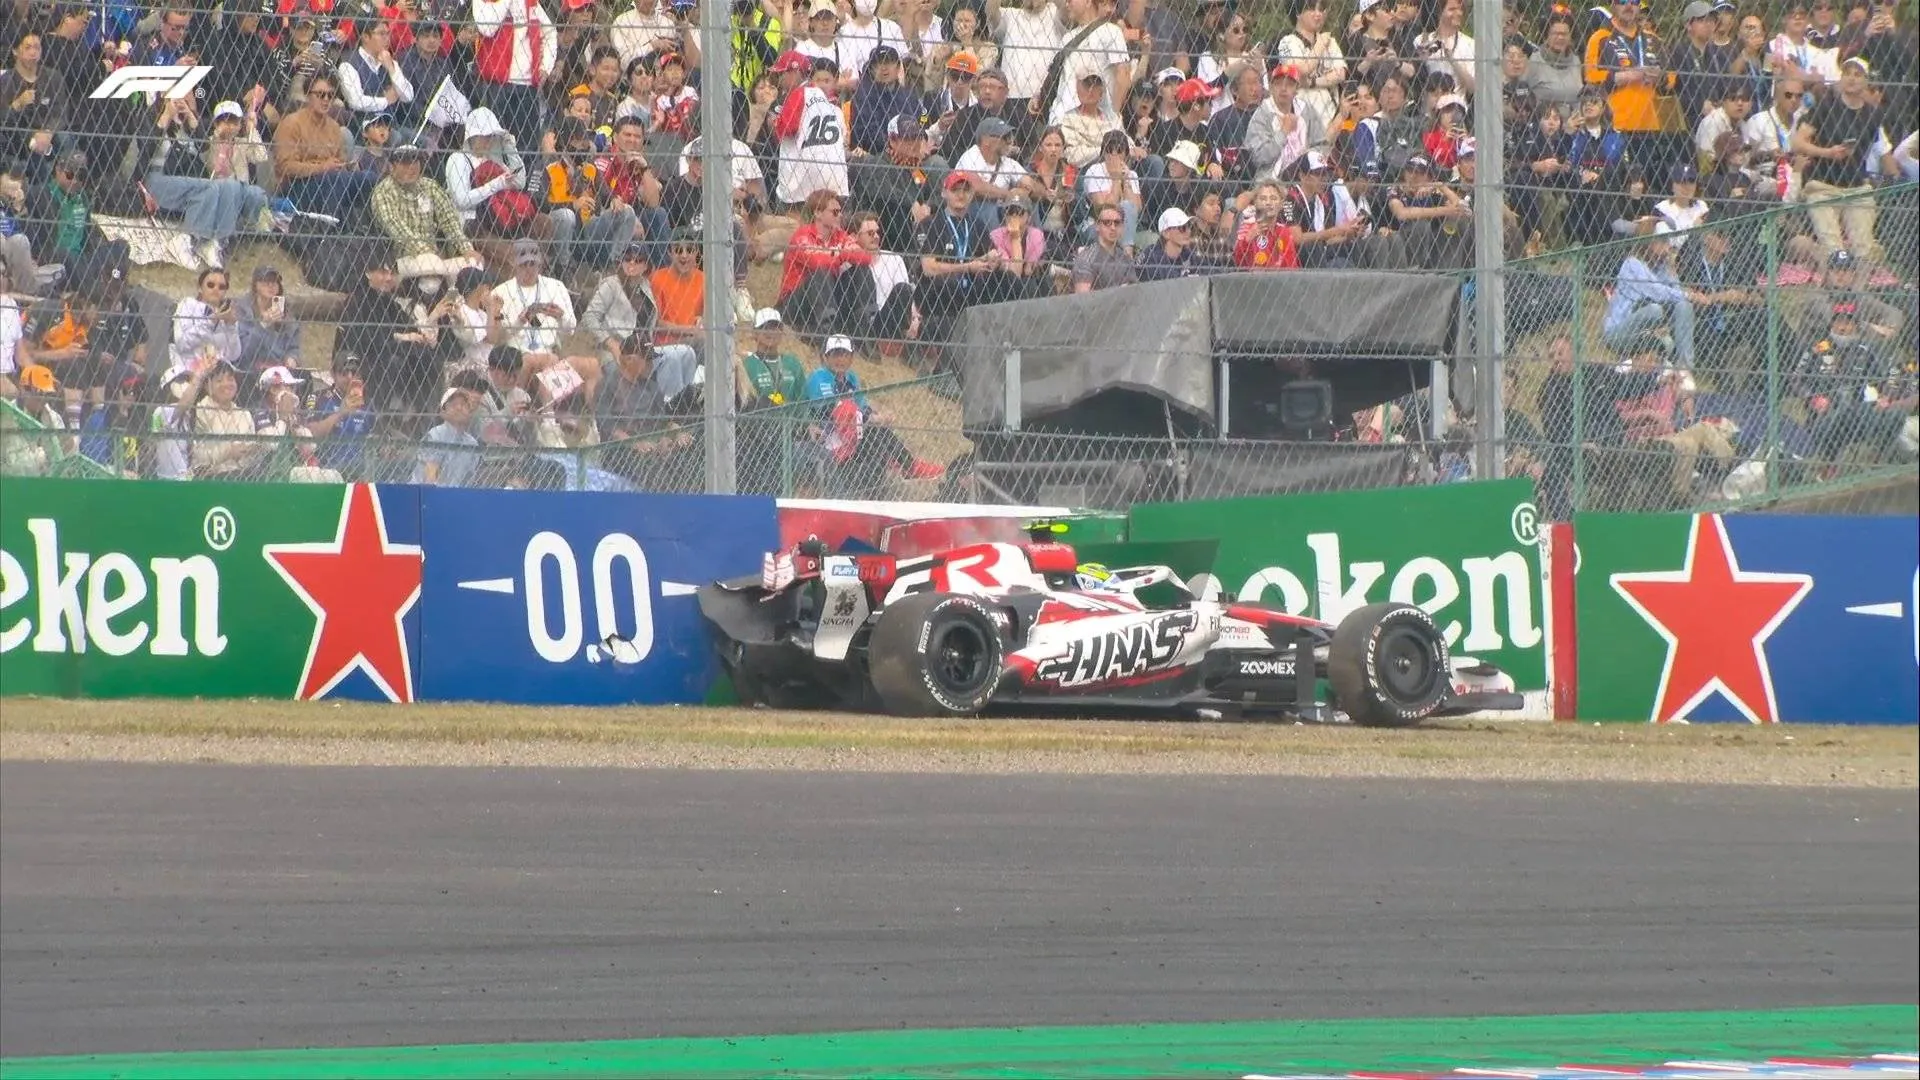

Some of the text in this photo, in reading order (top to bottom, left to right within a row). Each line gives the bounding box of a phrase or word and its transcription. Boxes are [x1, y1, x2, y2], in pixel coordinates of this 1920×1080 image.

[801, 115, 840, 149] 16
[1187, 532, 1541, 652] ken
[822, 617, 855, 626] SINGHA
[1037, 610, 1199, 687] HAAS
[1240, 661, 1296, 675] ZOOMEX
[1366, 639, 1379, 689] ZERO
